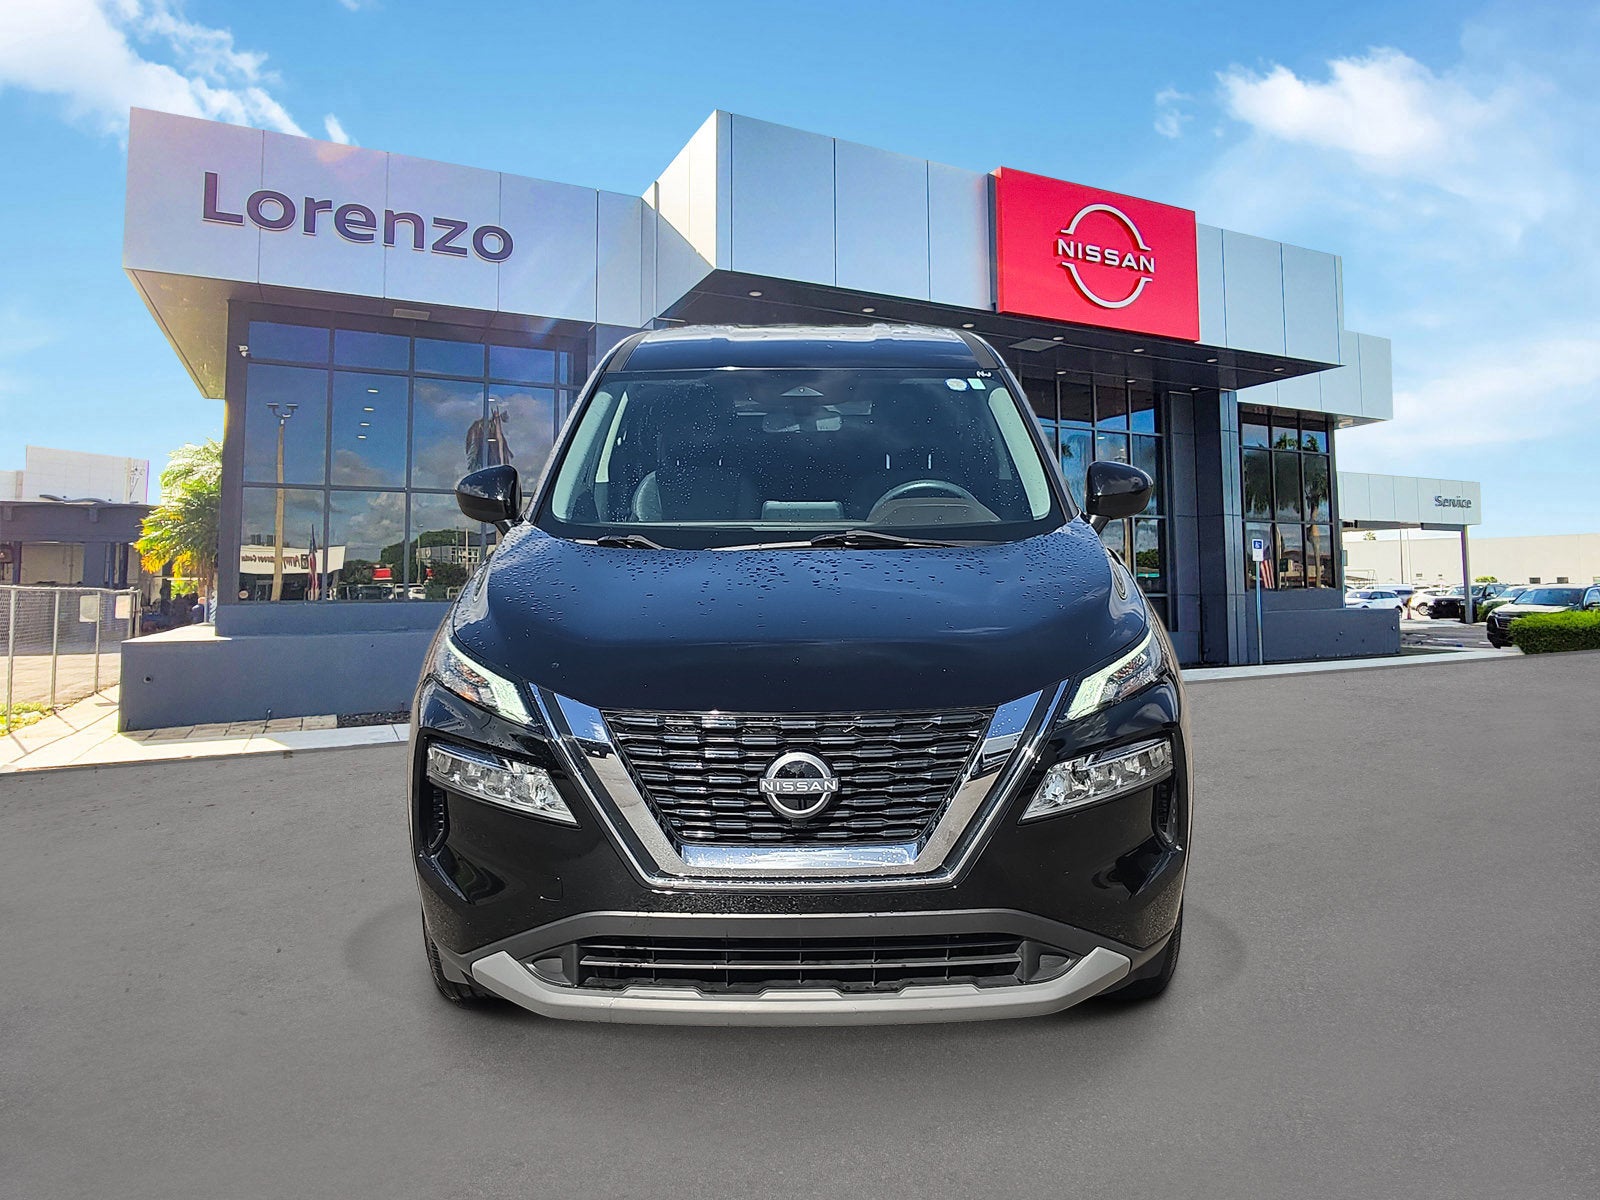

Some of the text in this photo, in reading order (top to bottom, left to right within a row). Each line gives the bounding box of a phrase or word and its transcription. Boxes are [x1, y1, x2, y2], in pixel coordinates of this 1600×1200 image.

[202, 171, 514, 262] Lorenzo
[1057, 238, 1155, 273] NISSAN
[1434, 495, 1472, 508] Service
[761, 780, 836, 791] NISSAN
